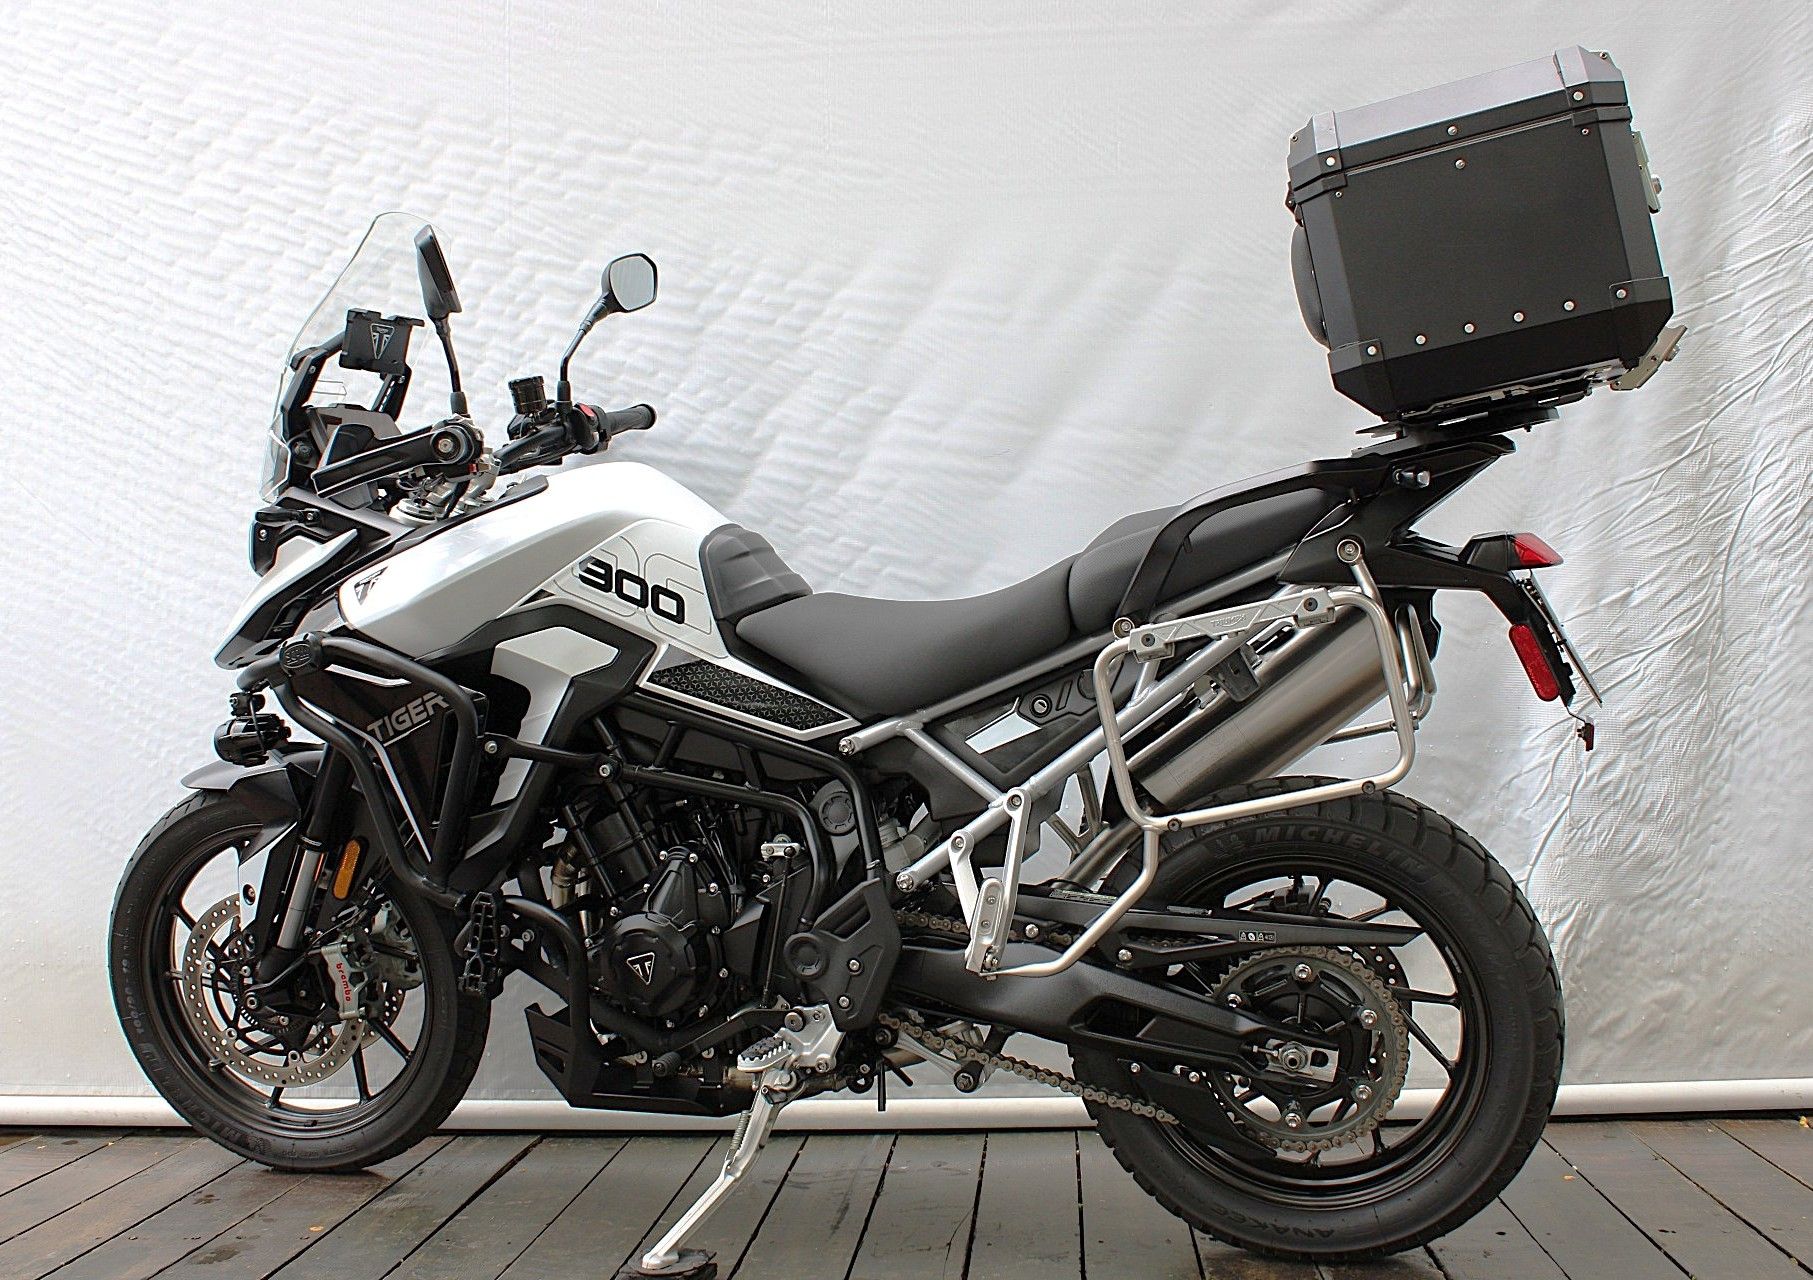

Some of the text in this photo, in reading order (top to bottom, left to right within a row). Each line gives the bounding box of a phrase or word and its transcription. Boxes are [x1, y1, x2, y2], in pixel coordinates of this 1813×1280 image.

[366, 691, 450, 742] TIGER
[1254, 825, 1426, 874] MICHELIN
[335, 962, 352, 1002] brembo
